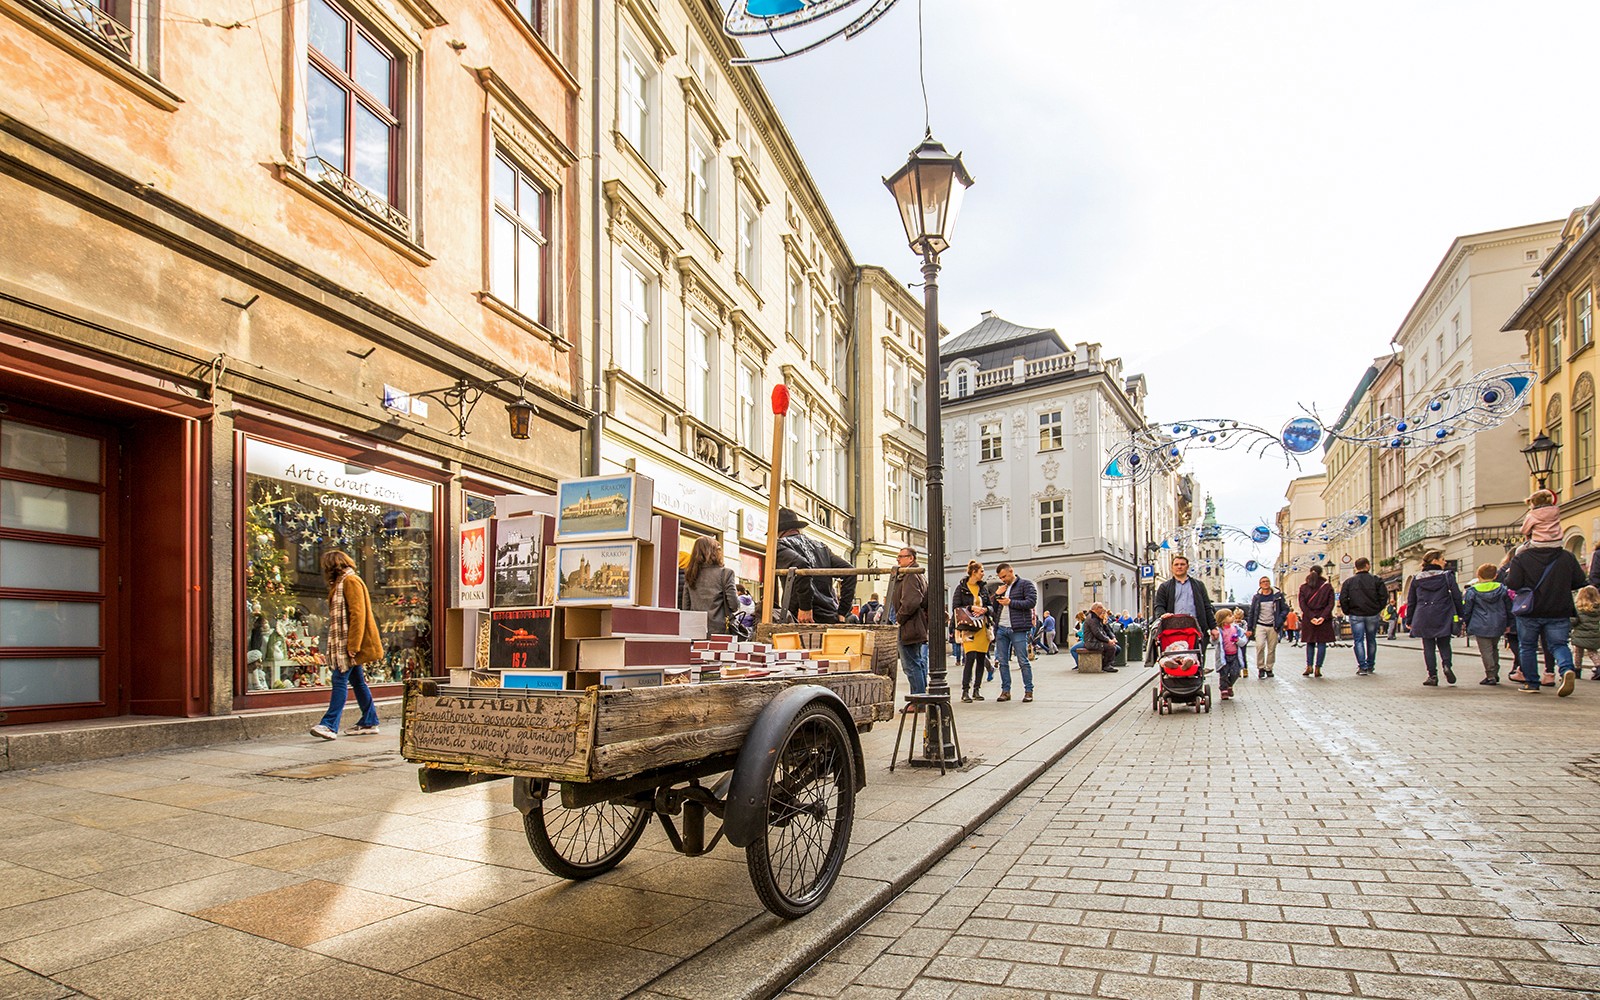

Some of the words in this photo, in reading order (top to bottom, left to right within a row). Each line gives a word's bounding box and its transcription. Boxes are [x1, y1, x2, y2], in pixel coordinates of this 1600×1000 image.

[285, 463, 315, 481] Art
[317, 470, 329, 486] &
[334, 477, 371, 495] craft
[374, 486, 404, 502] store
[320, 494, 368, 513] Grodzka
[368, 504, 381, 515] 36
[1472, 536, 1526, 548] BALATON
[1143, 566, 1151, 576] P
[461, 590, 485, 601] POLSKA
[512, 652, 521, 668] IS
[521, 652, 527, 668] 2
[453, 735, 467, 748] do
